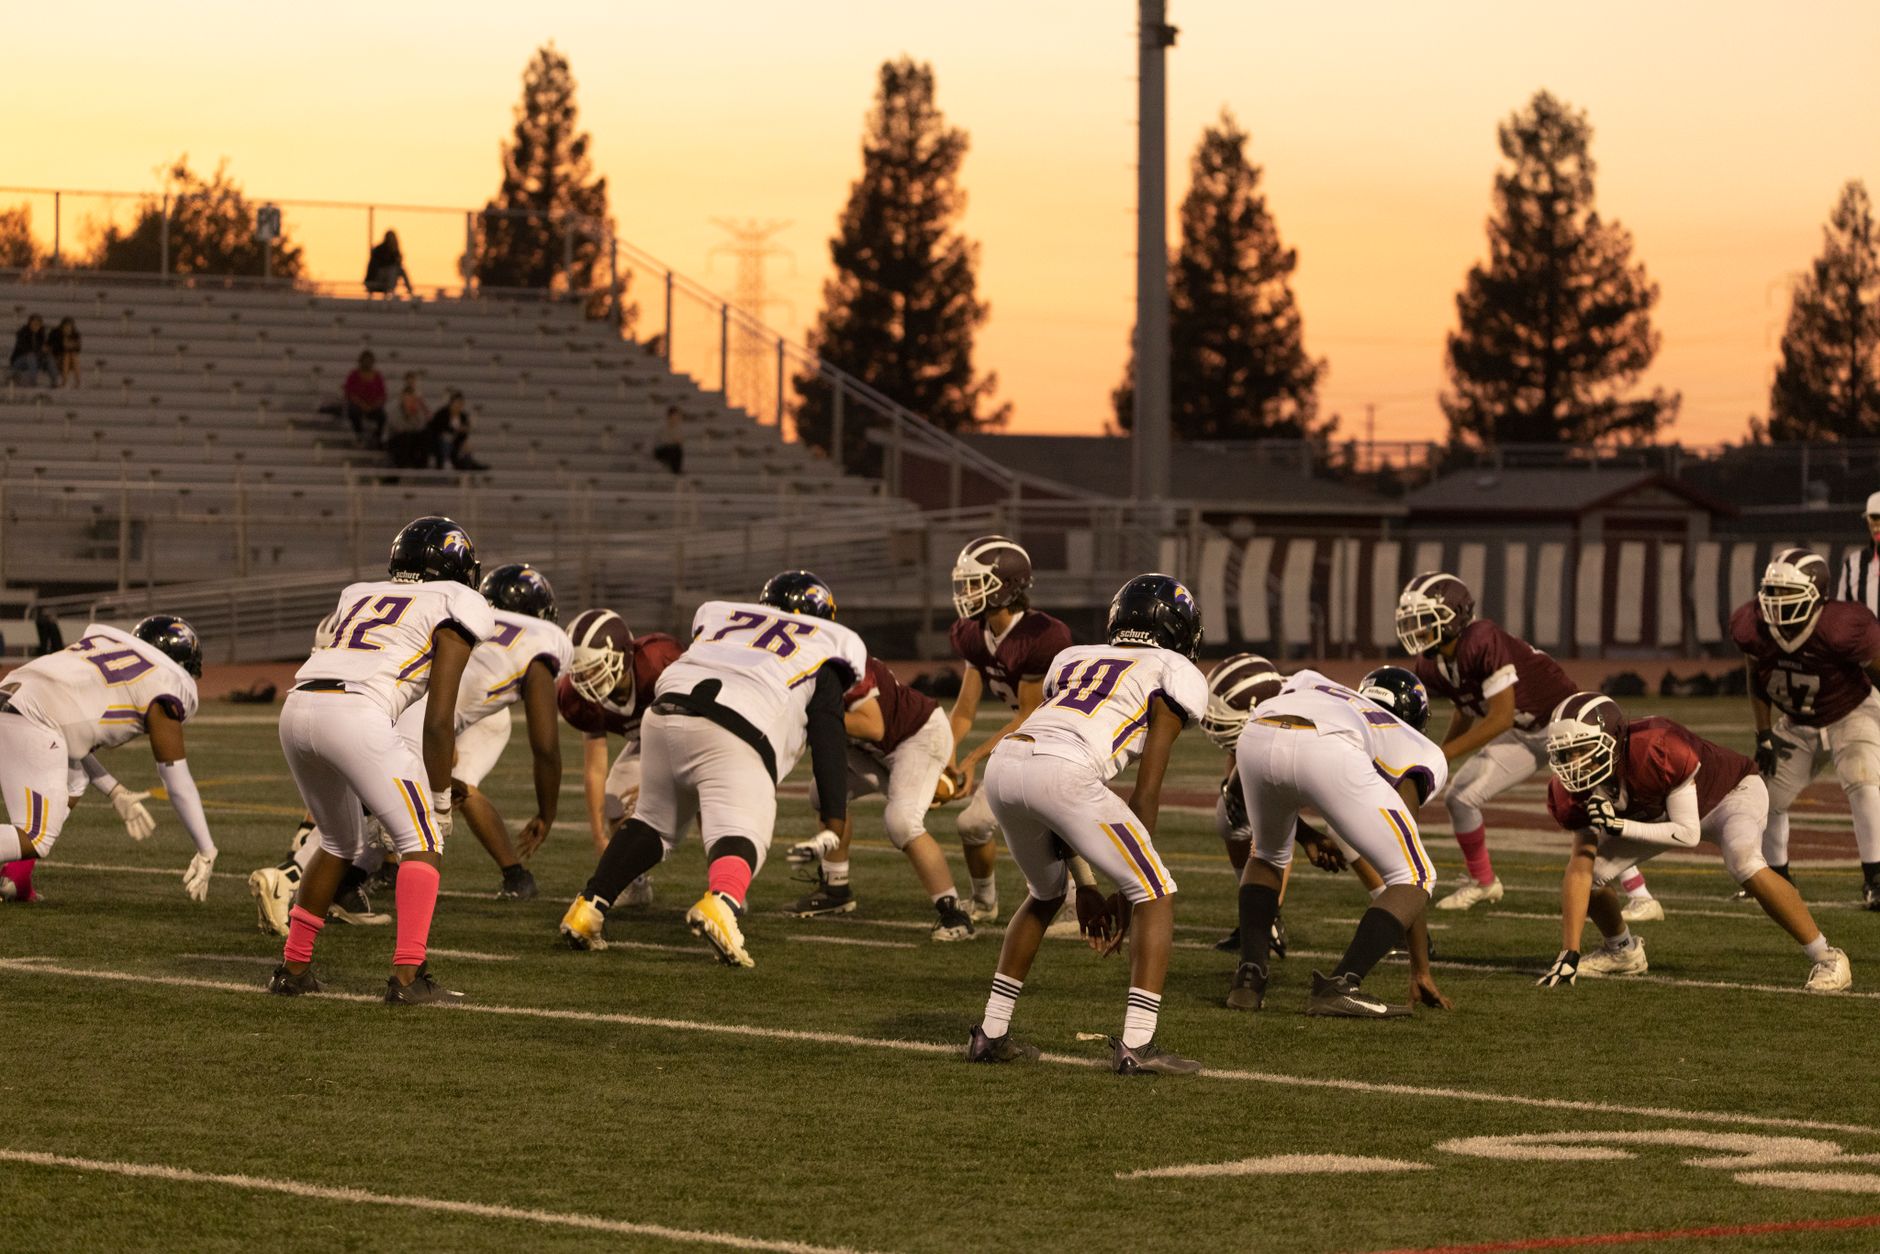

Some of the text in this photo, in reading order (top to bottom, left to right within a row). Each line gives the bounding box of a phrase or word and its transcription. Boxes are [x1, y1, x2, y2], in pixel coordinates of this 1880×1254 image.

[326, 594, 416, 652] 12
[704, 609, 818, 662] 76
[1120, 628, 1150, 640] schutt
[1052, 656, 1138, 719] 10
[1766, 669, 1821, 716] 47
